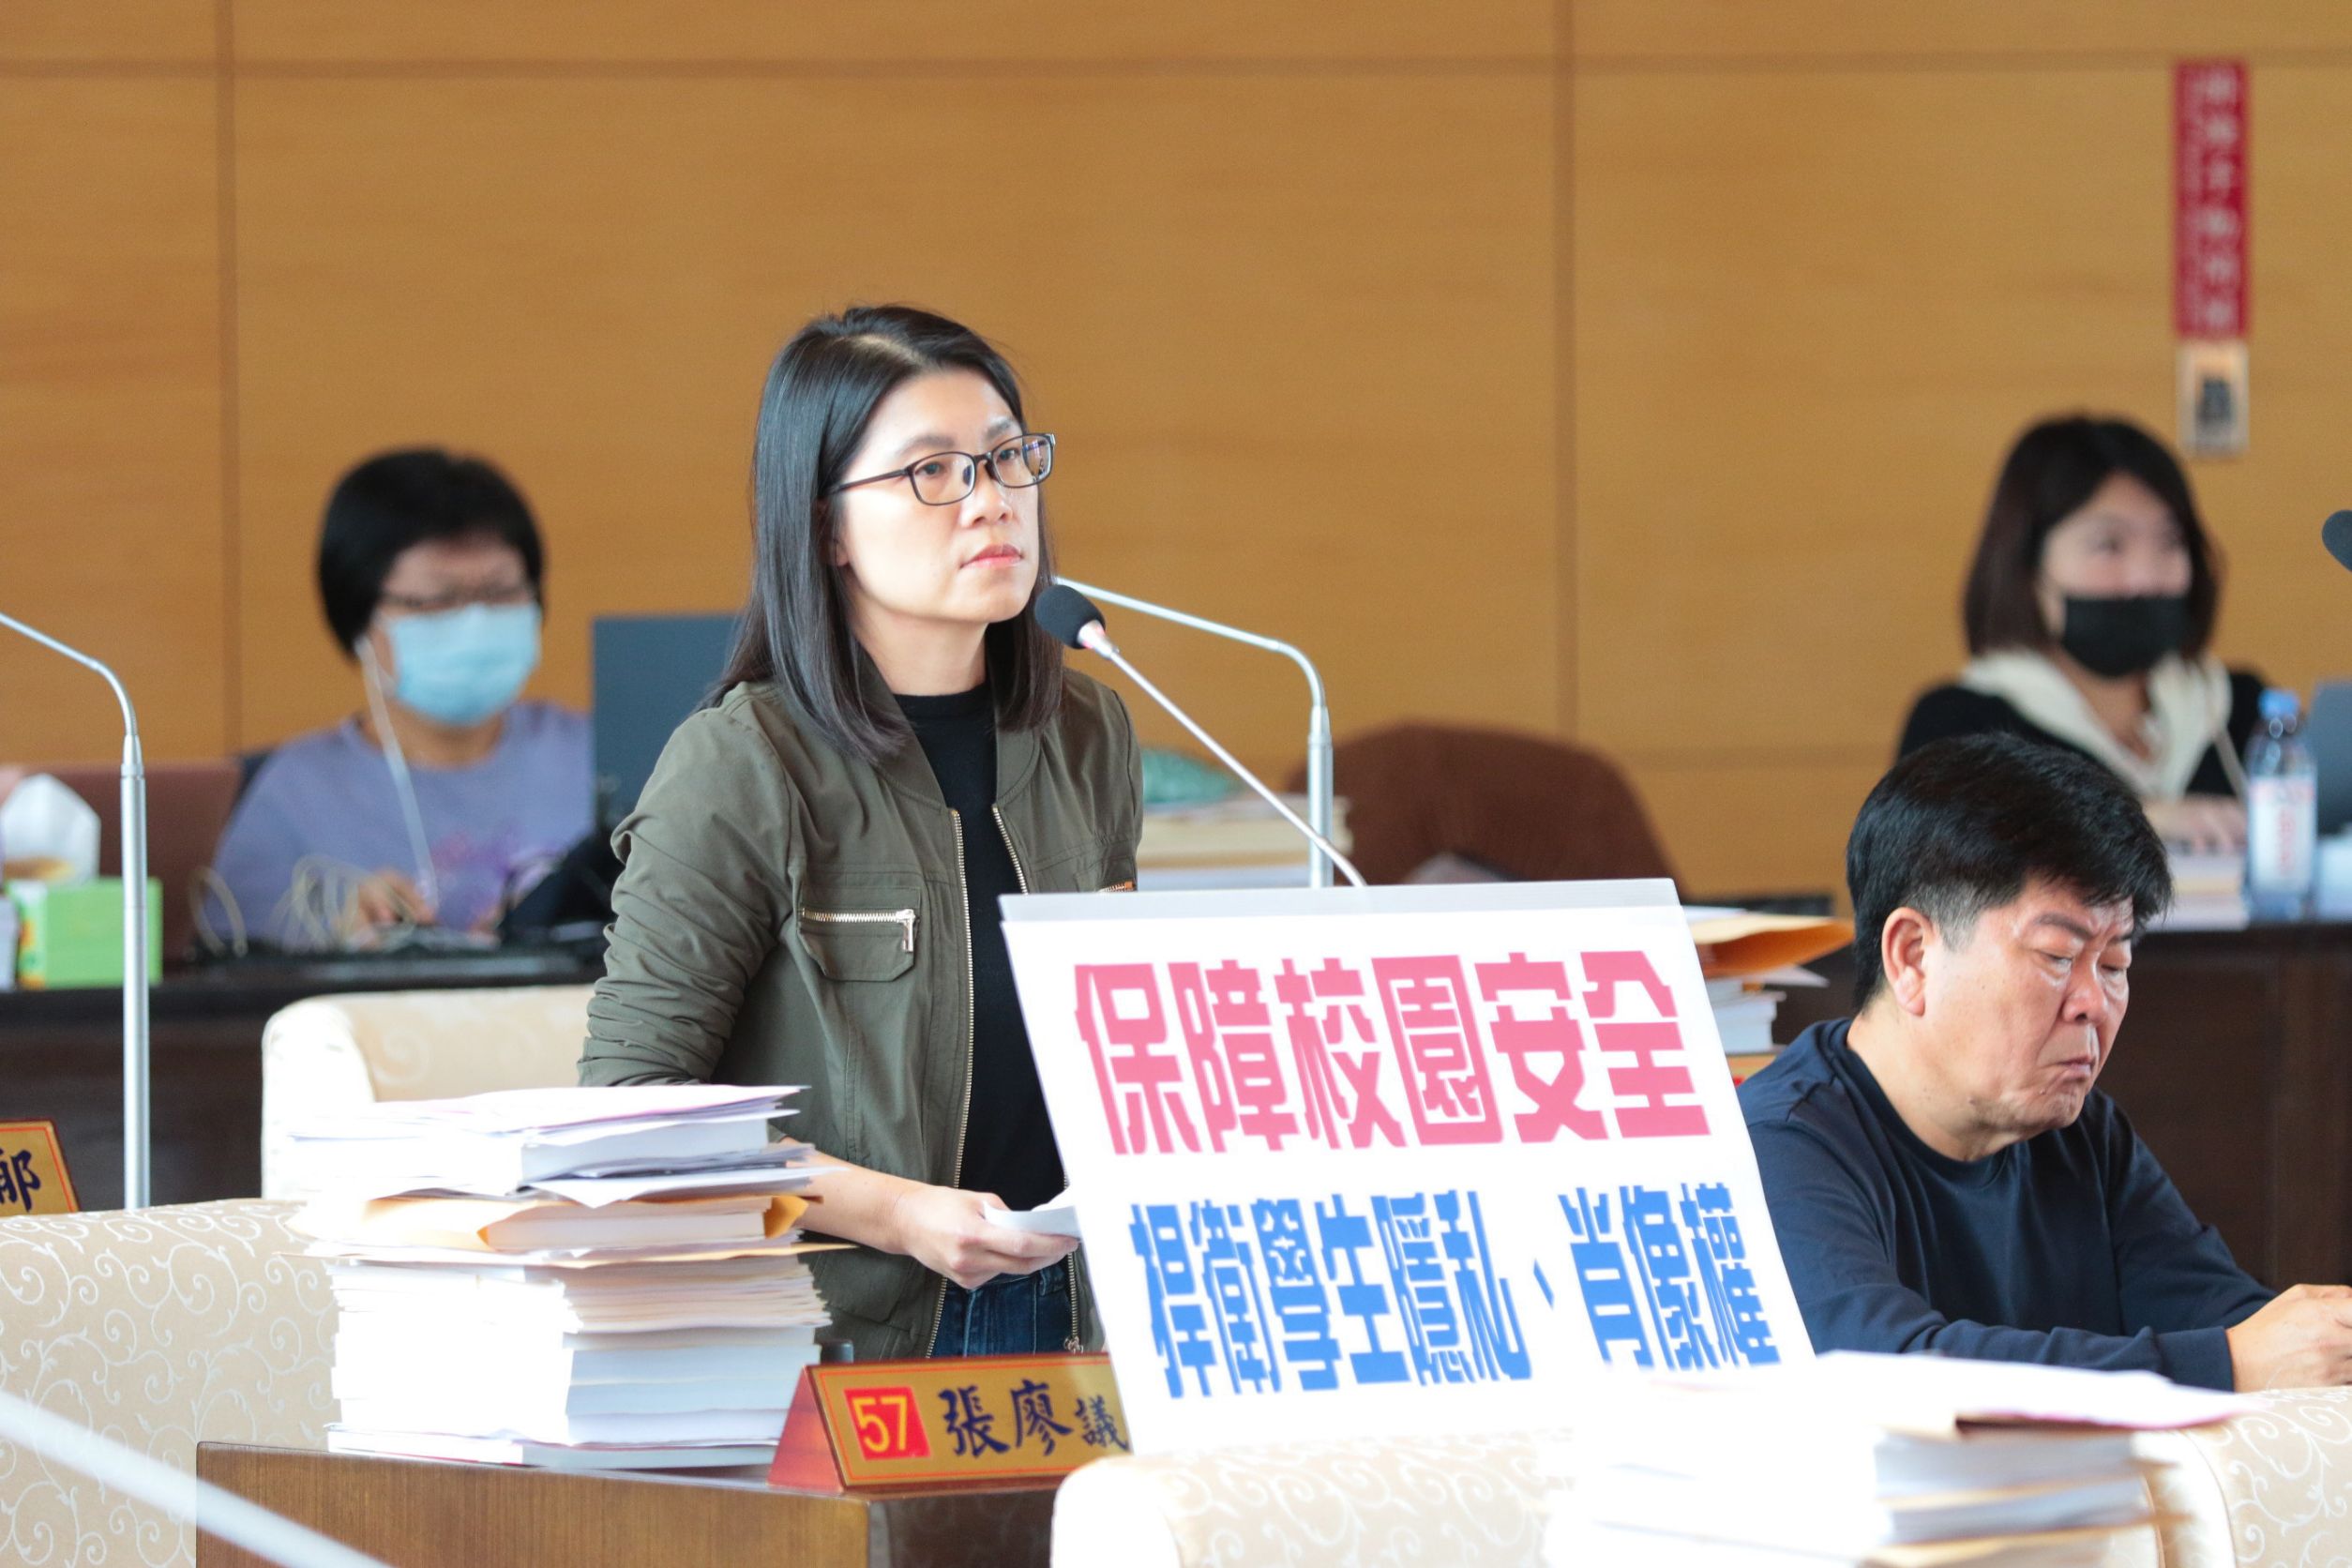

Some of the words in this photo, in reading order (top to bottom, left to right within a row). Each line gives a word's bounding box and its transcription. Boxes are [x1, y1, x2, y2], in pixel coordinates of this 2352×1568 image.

[1074, 950, 1711, 1155] 保障校園安全
[851, 1395, 908, 1454] 57
